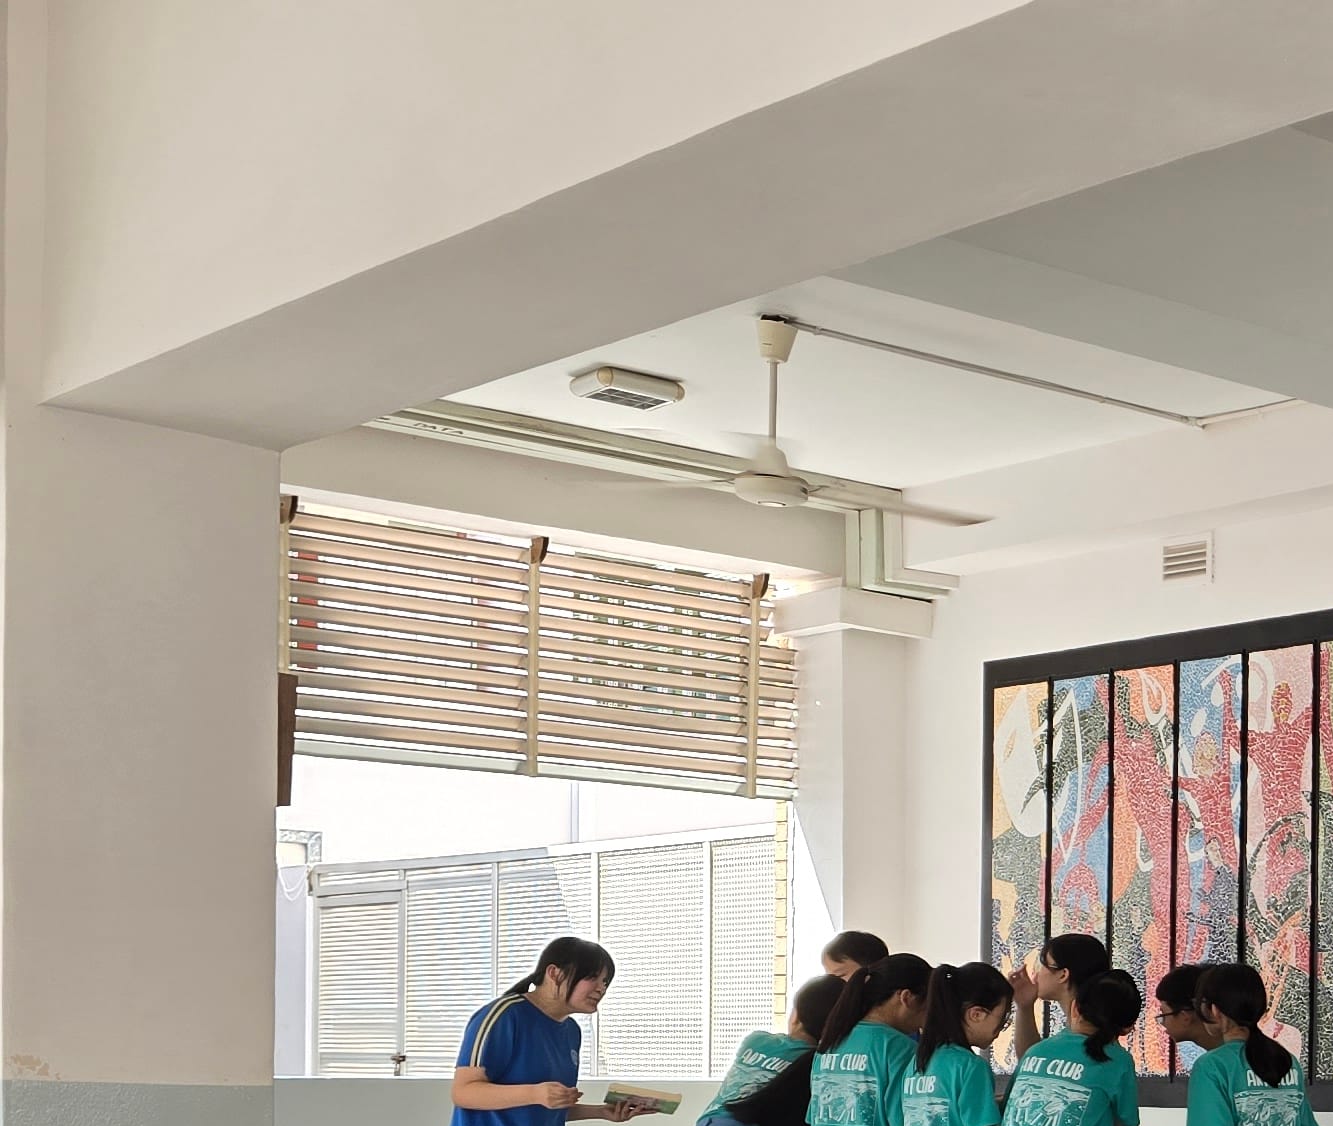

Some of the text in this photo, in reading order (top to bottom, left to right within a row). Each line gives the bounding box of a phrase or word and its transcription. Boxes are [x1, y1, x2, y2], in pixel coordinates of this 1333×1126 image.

[840, 1053, 868, 1072] CLUB
[1020, 1056, 1085, 1081] ART CLUB
[915, 1075, 937, 1093] CLUB
